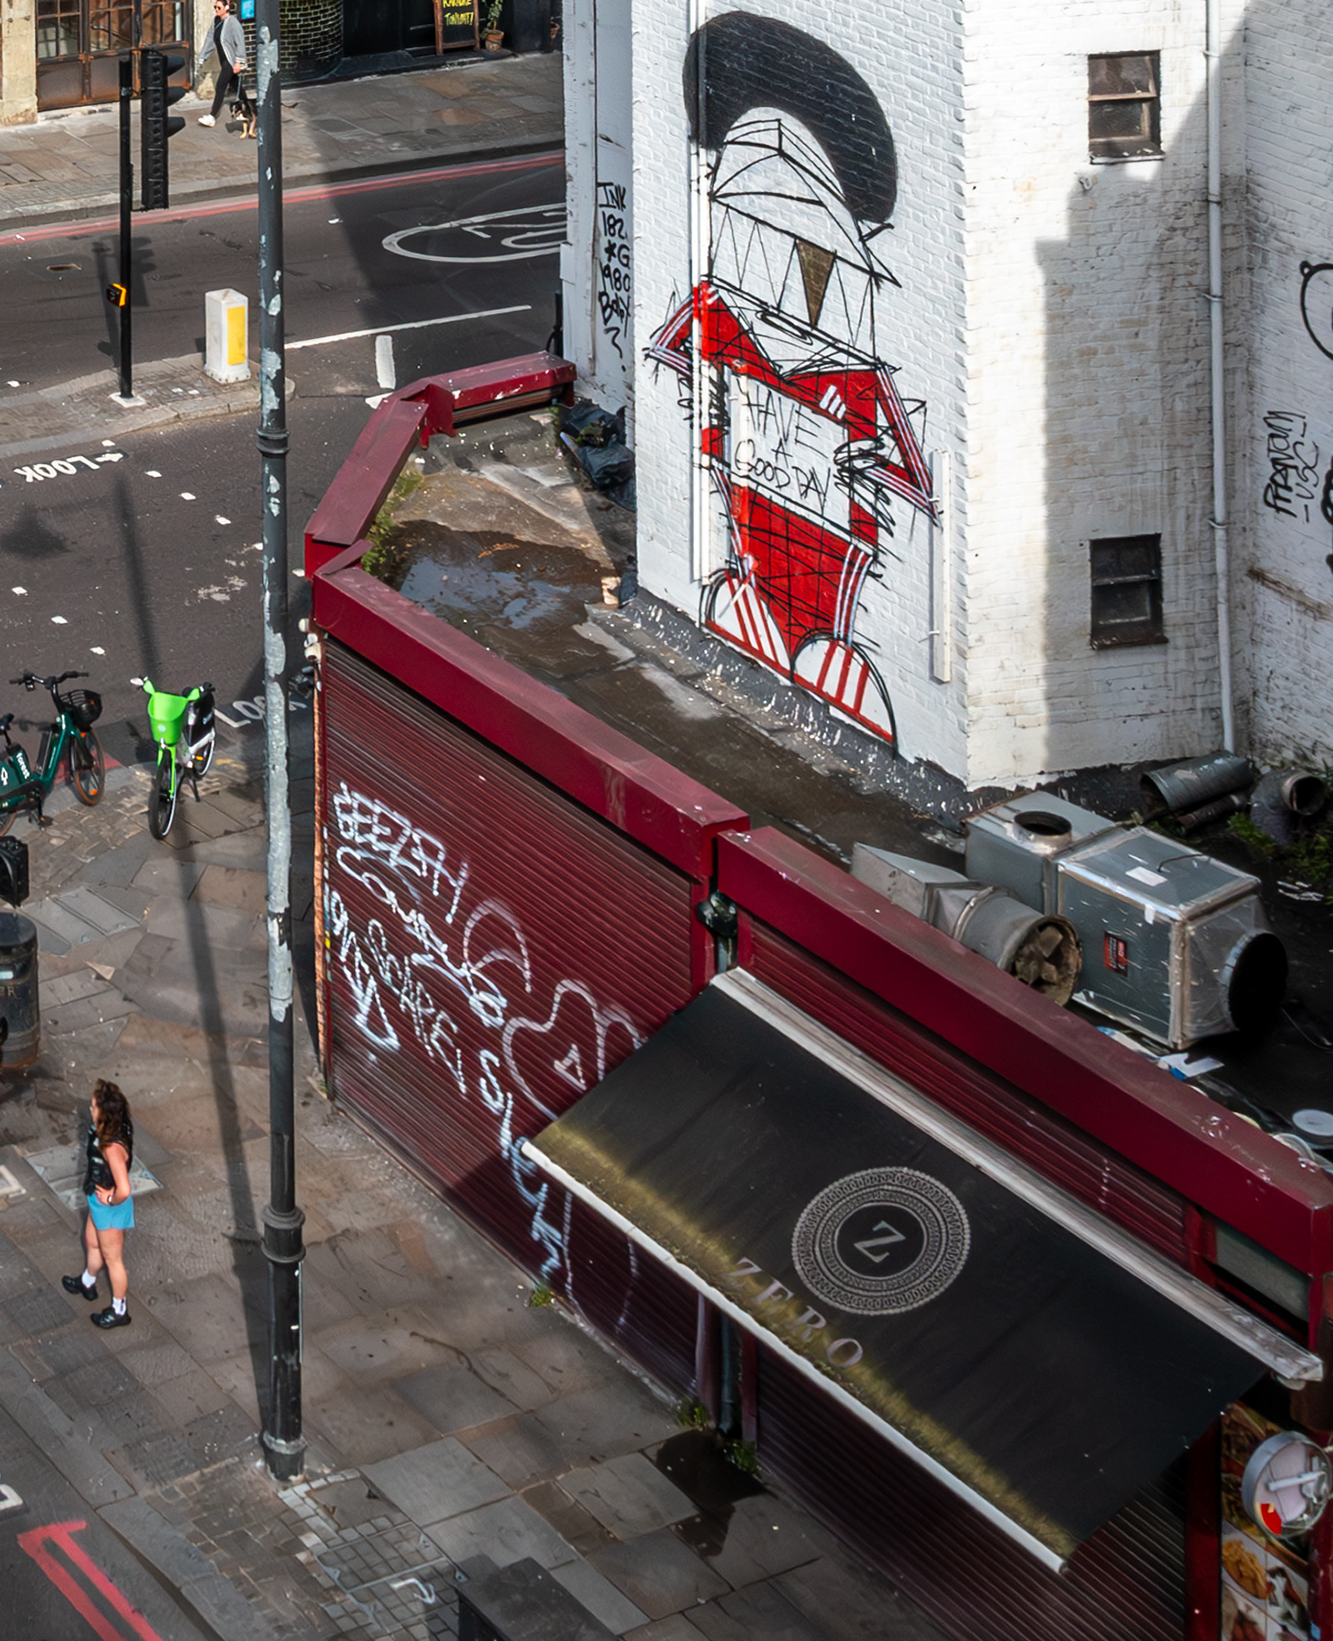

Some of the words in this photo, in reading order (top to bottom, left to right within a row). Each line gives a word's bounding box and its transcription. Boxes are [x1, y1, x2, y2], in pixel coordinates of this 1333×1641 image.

[13, 455, 101, 483] LOOK
[15, 751, 31, 781] forest
[852, 1219, 906, 1263] Z
[730, 1257, 866, 1369] ZERO
